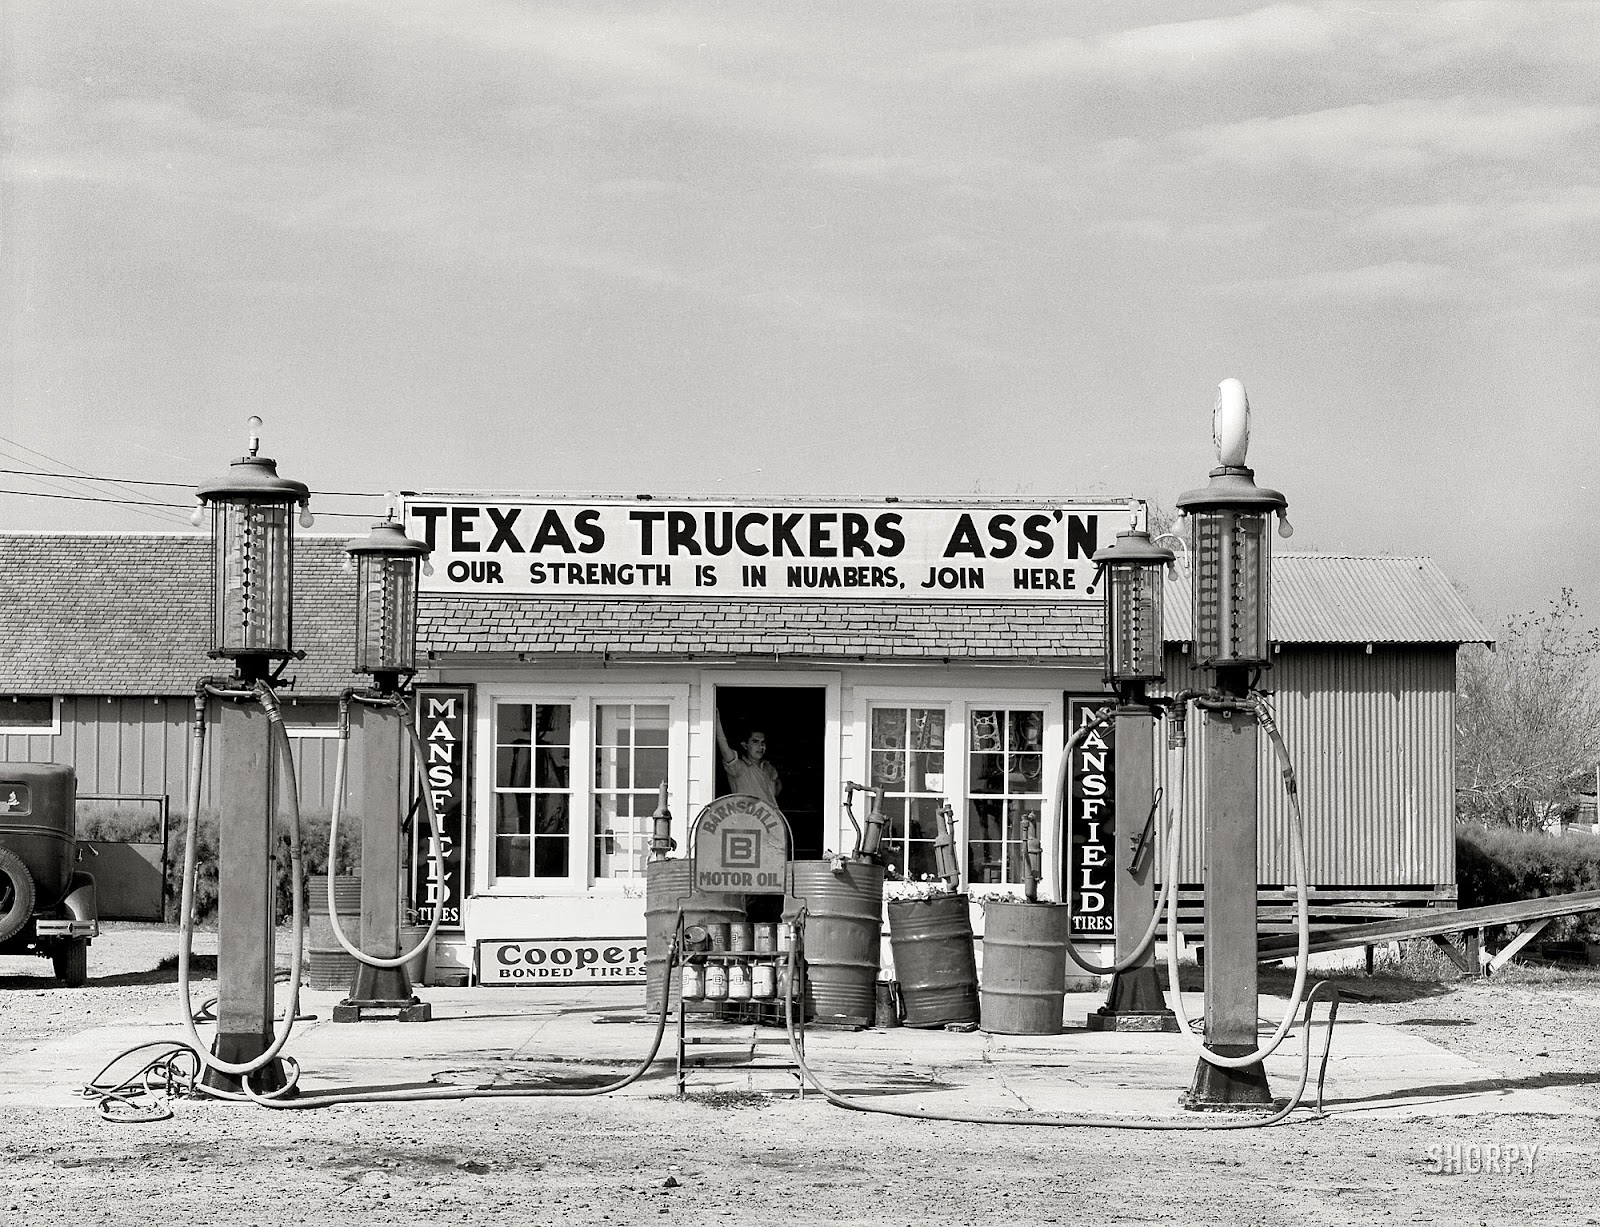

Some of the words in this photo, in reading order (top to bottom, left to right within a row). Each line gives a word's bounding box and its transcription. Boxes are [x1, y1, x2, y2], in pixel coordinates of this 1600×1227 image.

[411, 506, 605, 554] TEXAS
[629, 510, 906, 558] TRUCKERS
[942, 509, 1098, 560] ASS'N
[447, 560, 504, 584] OUR
[530, 562, 671, 586] STRENGTH
[695, 564, 717, 587] IS
[742, 565, 766, 588] IN
[787, 565, 905, 590] NUMBERS,
[921, 566, 984, 589] JOIN
[425, 698, 456, 903] MANSFIELD
[1080, 706, 1109, 913] MANSFIELD
[702, 801, 778, 835] BARNSDALL
[730, 837, 752, 860] B
[700, 872, 752, 886] MOTOR
[757, 872, 782, 887] OIL
[1072, 915, 1113, 930] TIRES
[497, 944, 647, 970] Cooper
[499, 968, 574, 978] BONDED
[586, 966, 647, 977] TIRES
